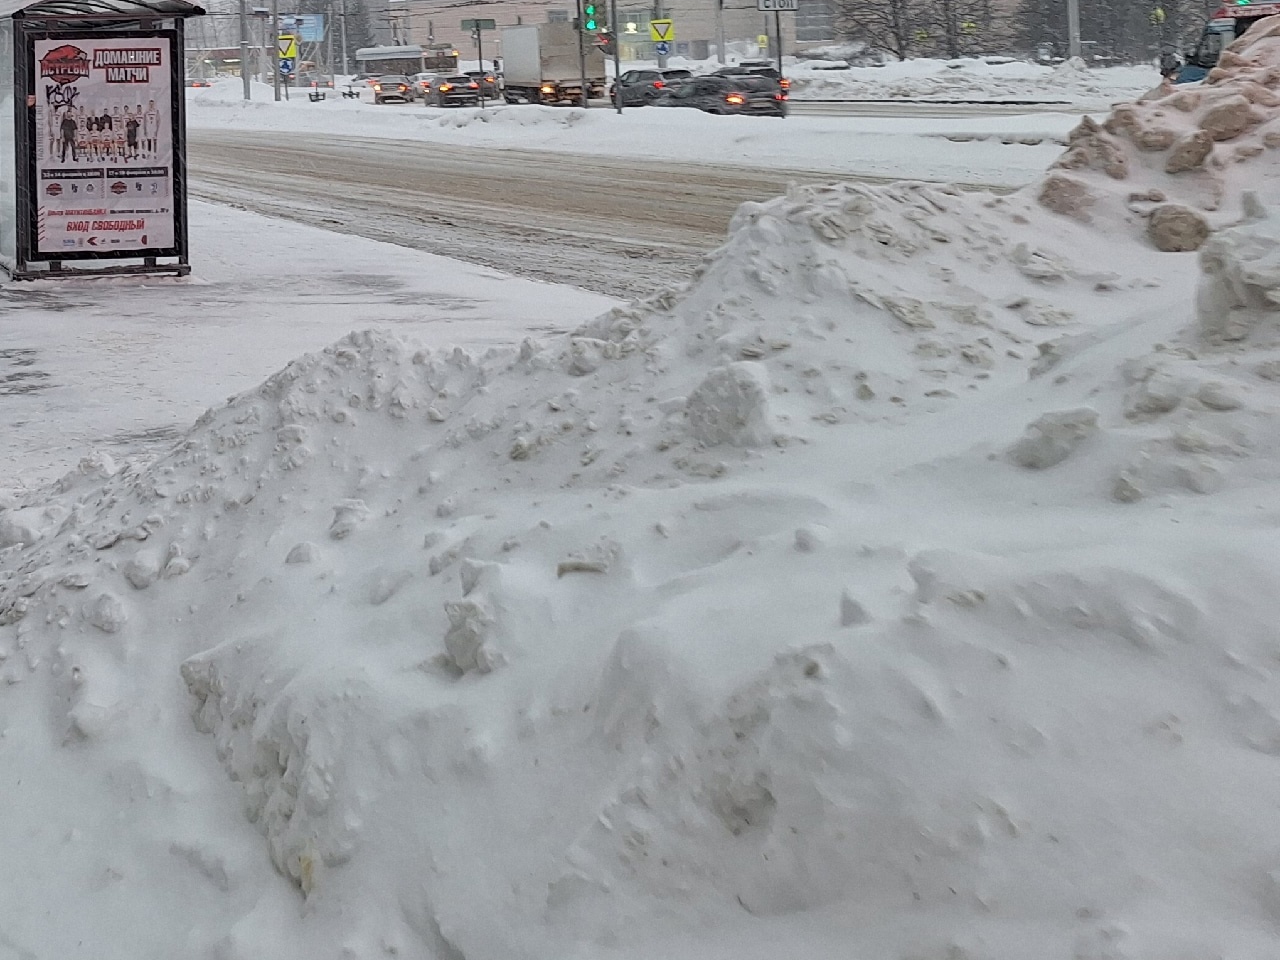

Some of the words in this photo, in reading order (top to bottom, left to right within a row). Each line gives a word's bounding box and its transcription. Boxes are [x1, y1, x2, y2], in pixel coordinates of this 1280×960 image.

[95, 51, 160, 67] ДОМАШНИЕ
[108, 68, 147, 81] МАТЧИ
[66, 221, 89, 232] ВХОД
[91, 218, 145, 232] СВОБОДНЫЙ
